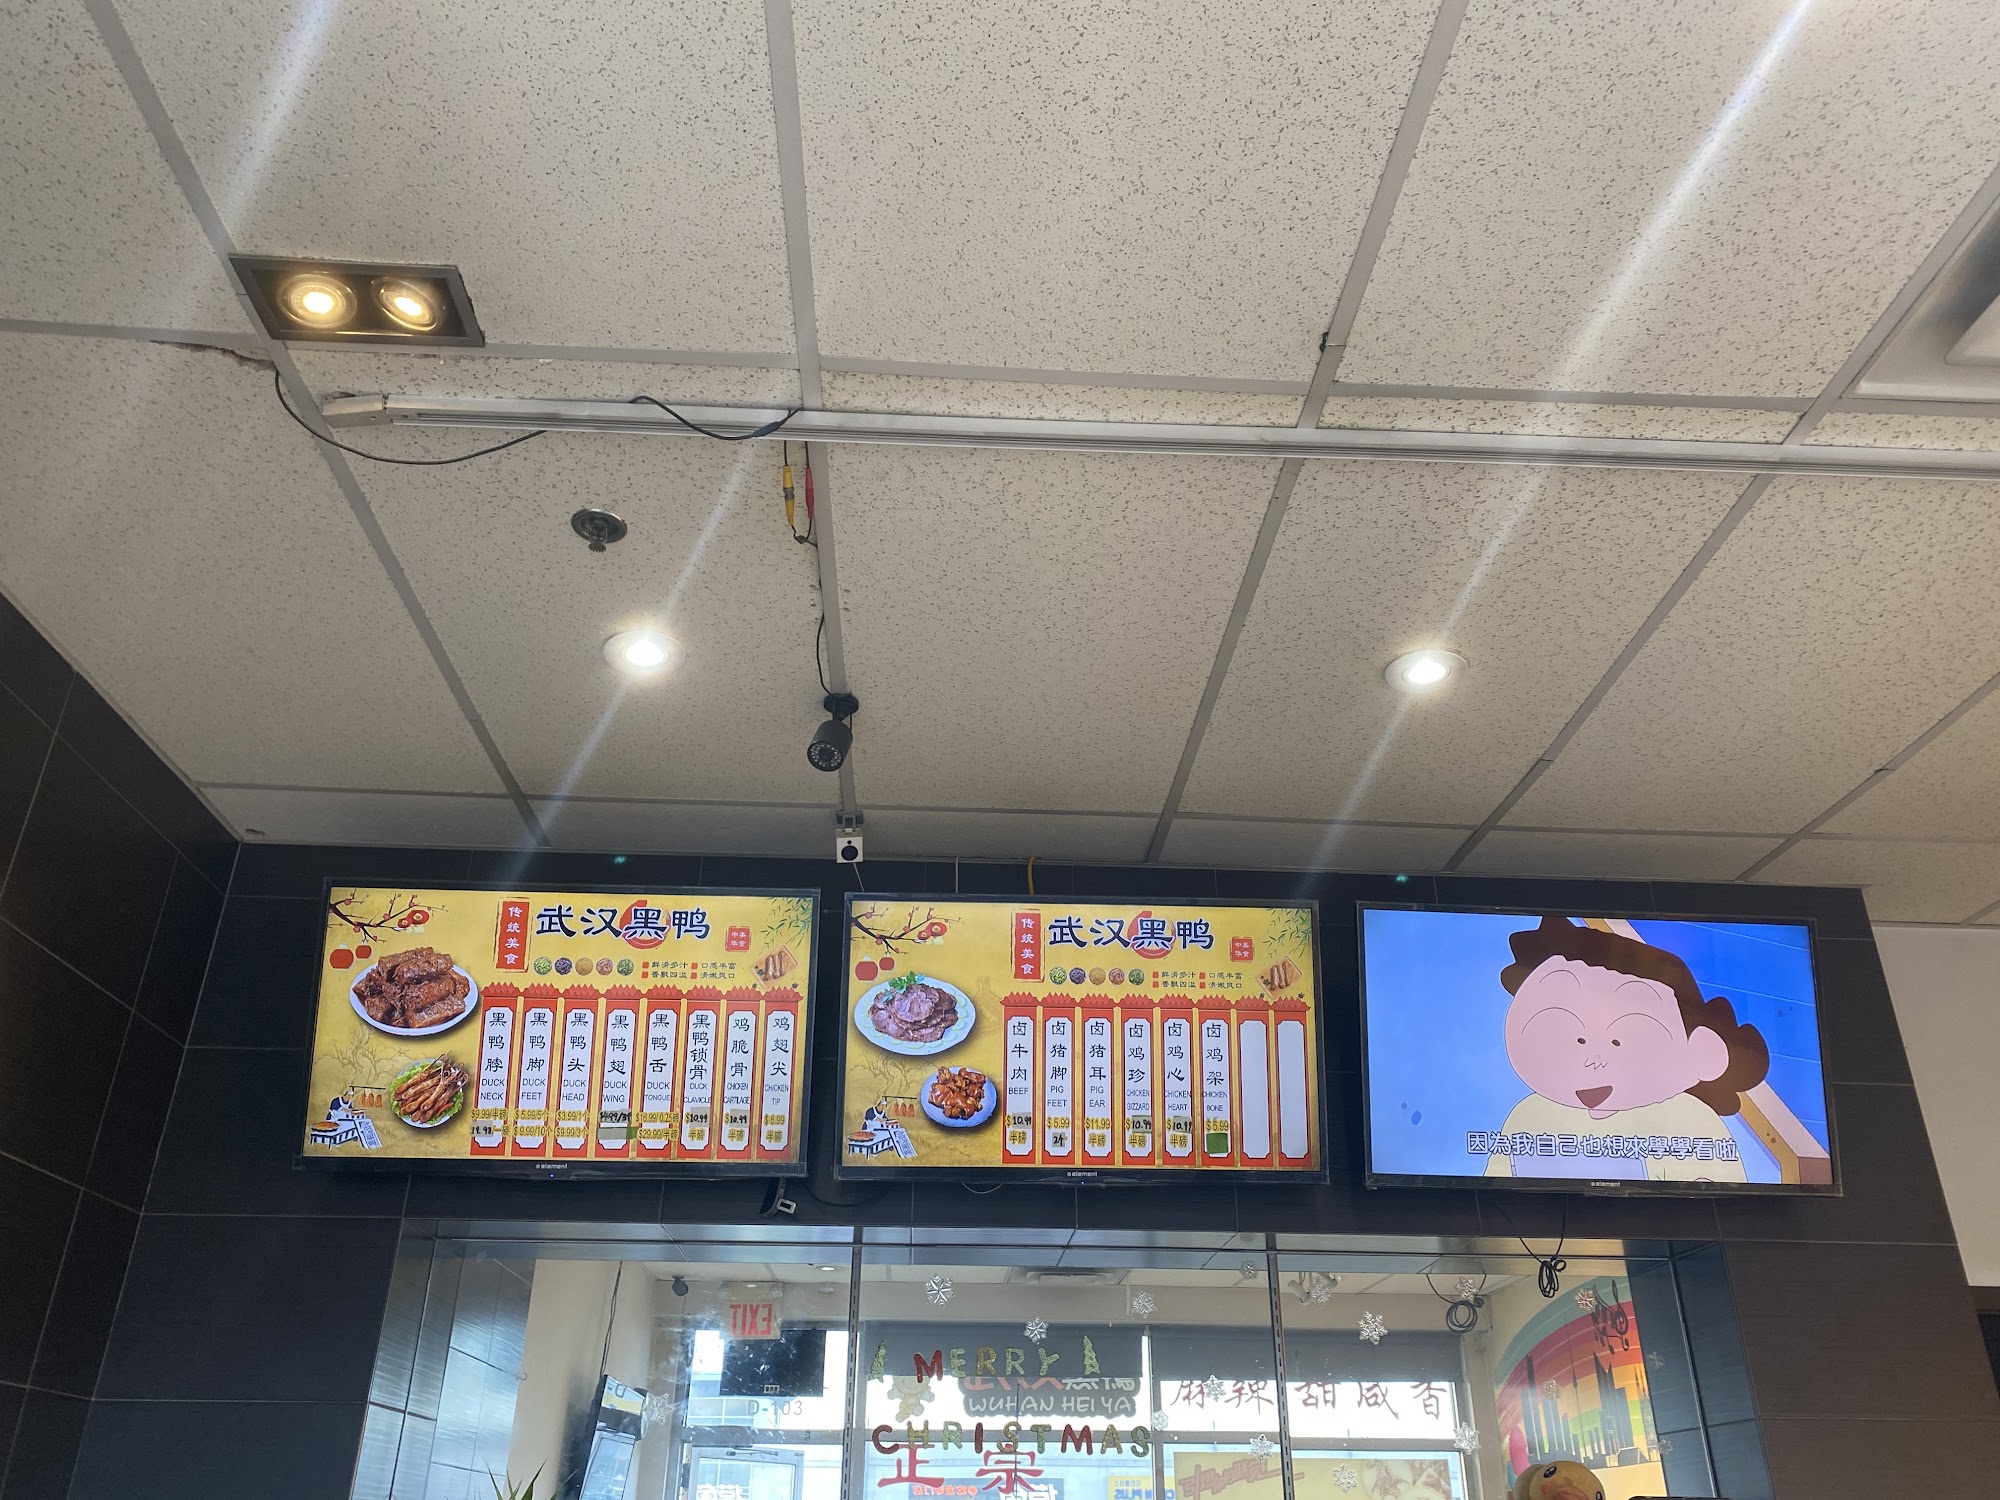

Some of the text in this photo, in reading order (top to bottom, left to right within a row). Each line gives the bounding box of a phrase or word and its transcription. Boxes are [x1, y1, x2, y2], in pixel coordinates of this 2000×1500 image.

[536, 904, 710, 940] 武汉黑鸭
[504, 905, 522, 965] 传统美食
[1048, 915, 1214, 950] 武汉黑鸭
[1020, 917, 1035, 974] 传统美食
[701, 962, 737, 970] 口感丰富
[1208, 972, 1243, 980] 口感丰富
[485, 1012, 507, 1072] 黑鸭脖
[526, 1012, 548, 1072] 黑鸭脚
[567, 1012, 588, 1072] 黑鸭头
[607, 1015, 629, 1074] 黑鸭翅
[649, 1013, 670, 1073] 黑鸭舌
[689, 1014, 711, 1080] 黑鸭锁骨
[730, 1017, 750, 1077] 鸡脆骨
[770, 1016, 790, 1076] 鸡翅尖
[1010, 1021, 1028, 1081] 卤牛肉
[1050, 1021, 1067, 1080] 卤猪脚
[1089, 1021, 1106, 1080] 卤猪耳
[1128, 1023, 1145, 1083] 卤鸡珍
[1167, 1022, 1185, 1082] 卤鸡心
[1206, 1023, 1224, 1086] 卤鸡架
[481, 1078, 505, 1087] DUCK
[522, 1078, 546, 1086] DUCK
[563, 1079, 587, 1087] DUCK
[604, 1081, 627, 1089] DUCK
[646, 1081, 670, 1090] DUCK
[689, 1082, 708, 1090] DUCK
[764, 1084, 789, 1092] CHICKEN
[480, 1092, 504, 1100] NECK
[521, 1092, 542, 1100] FEET
[1008, 1087, 1029, 1095] BEEF
[1050, 1085, 1064, 1094] PIG
[1090, 1085, 1104, 1094] PIG
[1126, 1089, 1150, 1097] CHICKEN
[1163, 1090, 1192, 1098] CHICKEN
[1201, 1091, 1228, 1099] CHICKEN
[562, 1093, 585, 1101] HEAD
[602, 1094, 625, 1102] WING
[771, 1097, 781, 1105] TIP
[1047, 1099, 1068, 1107] FEET
[1126, 1103, 1150, 1111] GIZZARD
[1168, 1103, 1188, 1111] HEART
[1206, 1104, 1223, 1112] BONE
[1466, 1131, 1739, 1161] 因為我自己也想來學學看啦
[913, 1347, 1060, 1383] MERRY
[748, 1399, 803, 1416] D-103
[968, 1396, 1132, 1413] WUHAN HEI YA
[871, 1420, 1151, 1458] CHRISTMAS
[877, 1443, 1044, 1495] 正宗
